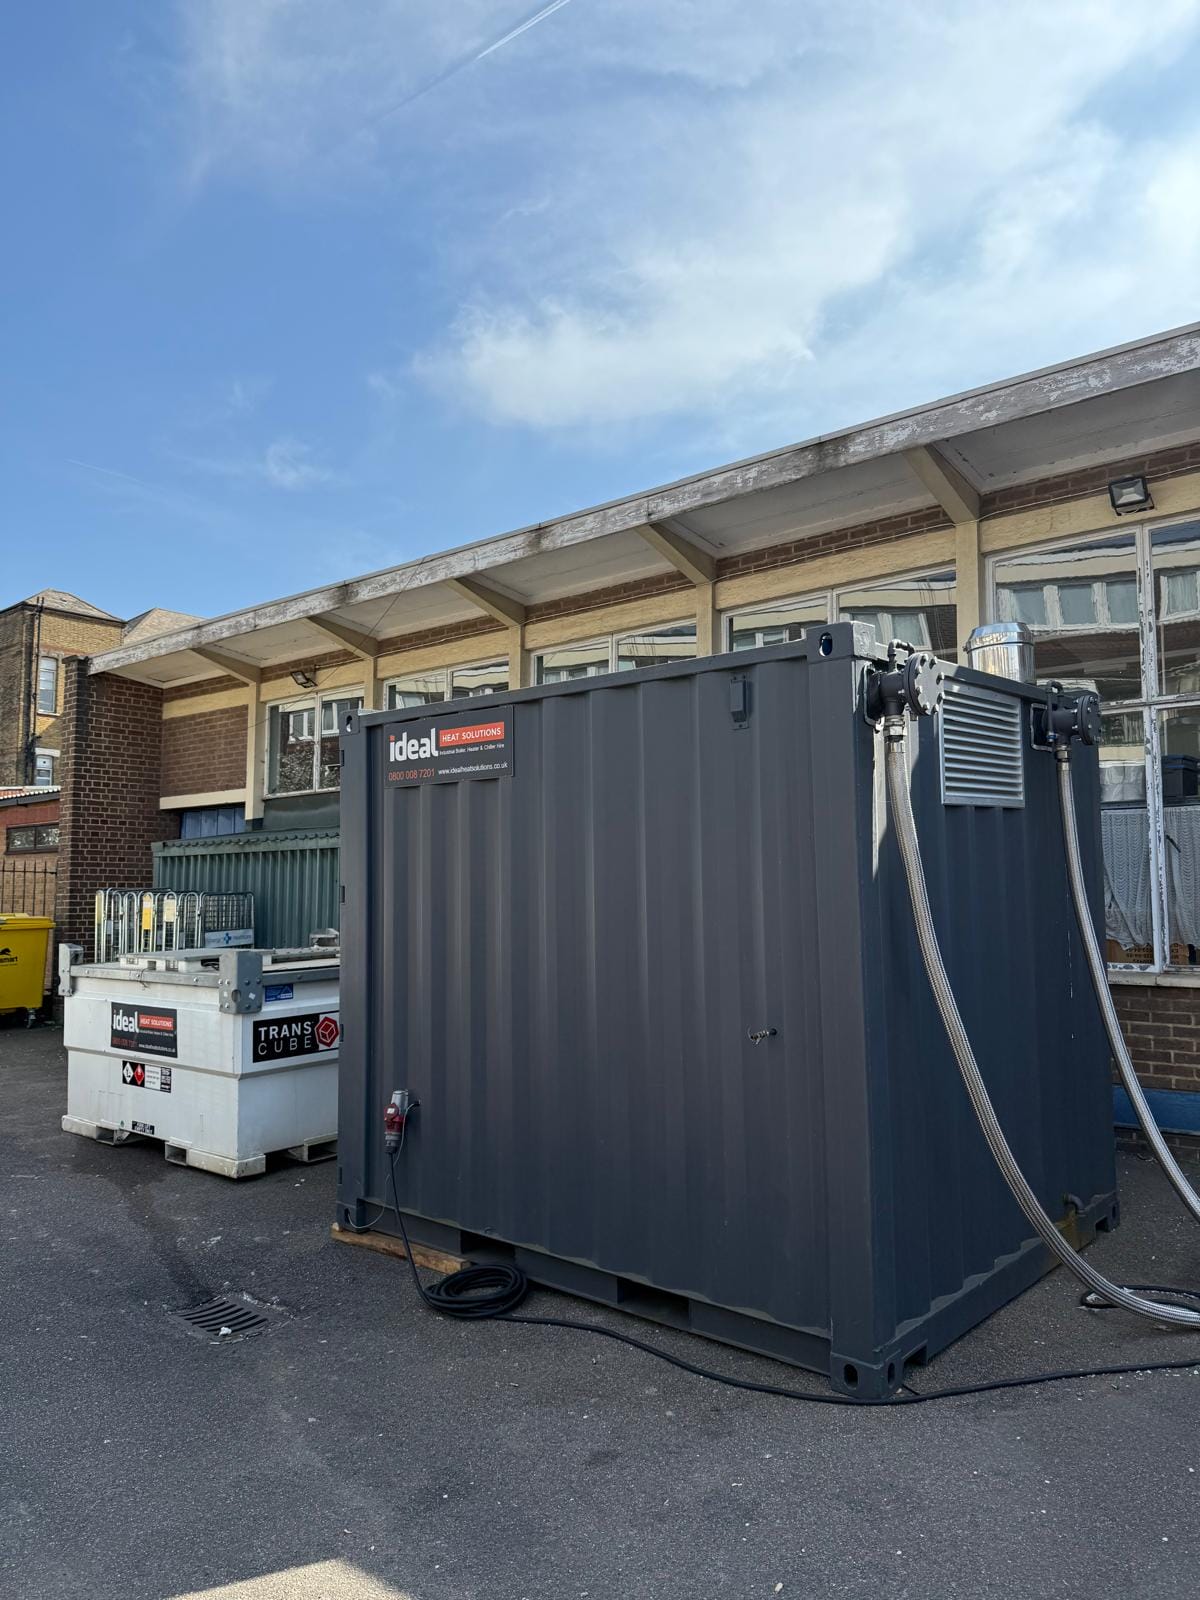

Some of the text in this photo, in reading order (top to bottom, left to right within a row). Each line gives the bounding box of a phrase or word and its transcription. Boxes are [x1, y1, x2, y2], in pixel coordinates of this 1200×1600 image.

[389, 727, 501, 761] ideal HEAT SOLUTIONS
[388, 768, 435, 781] 0800 008 7201
[113, 1009, 139, 1033] ideal
[258, 1021, 312, 1041] TRANS
[258, 1035, 312, 1055] CUBE
